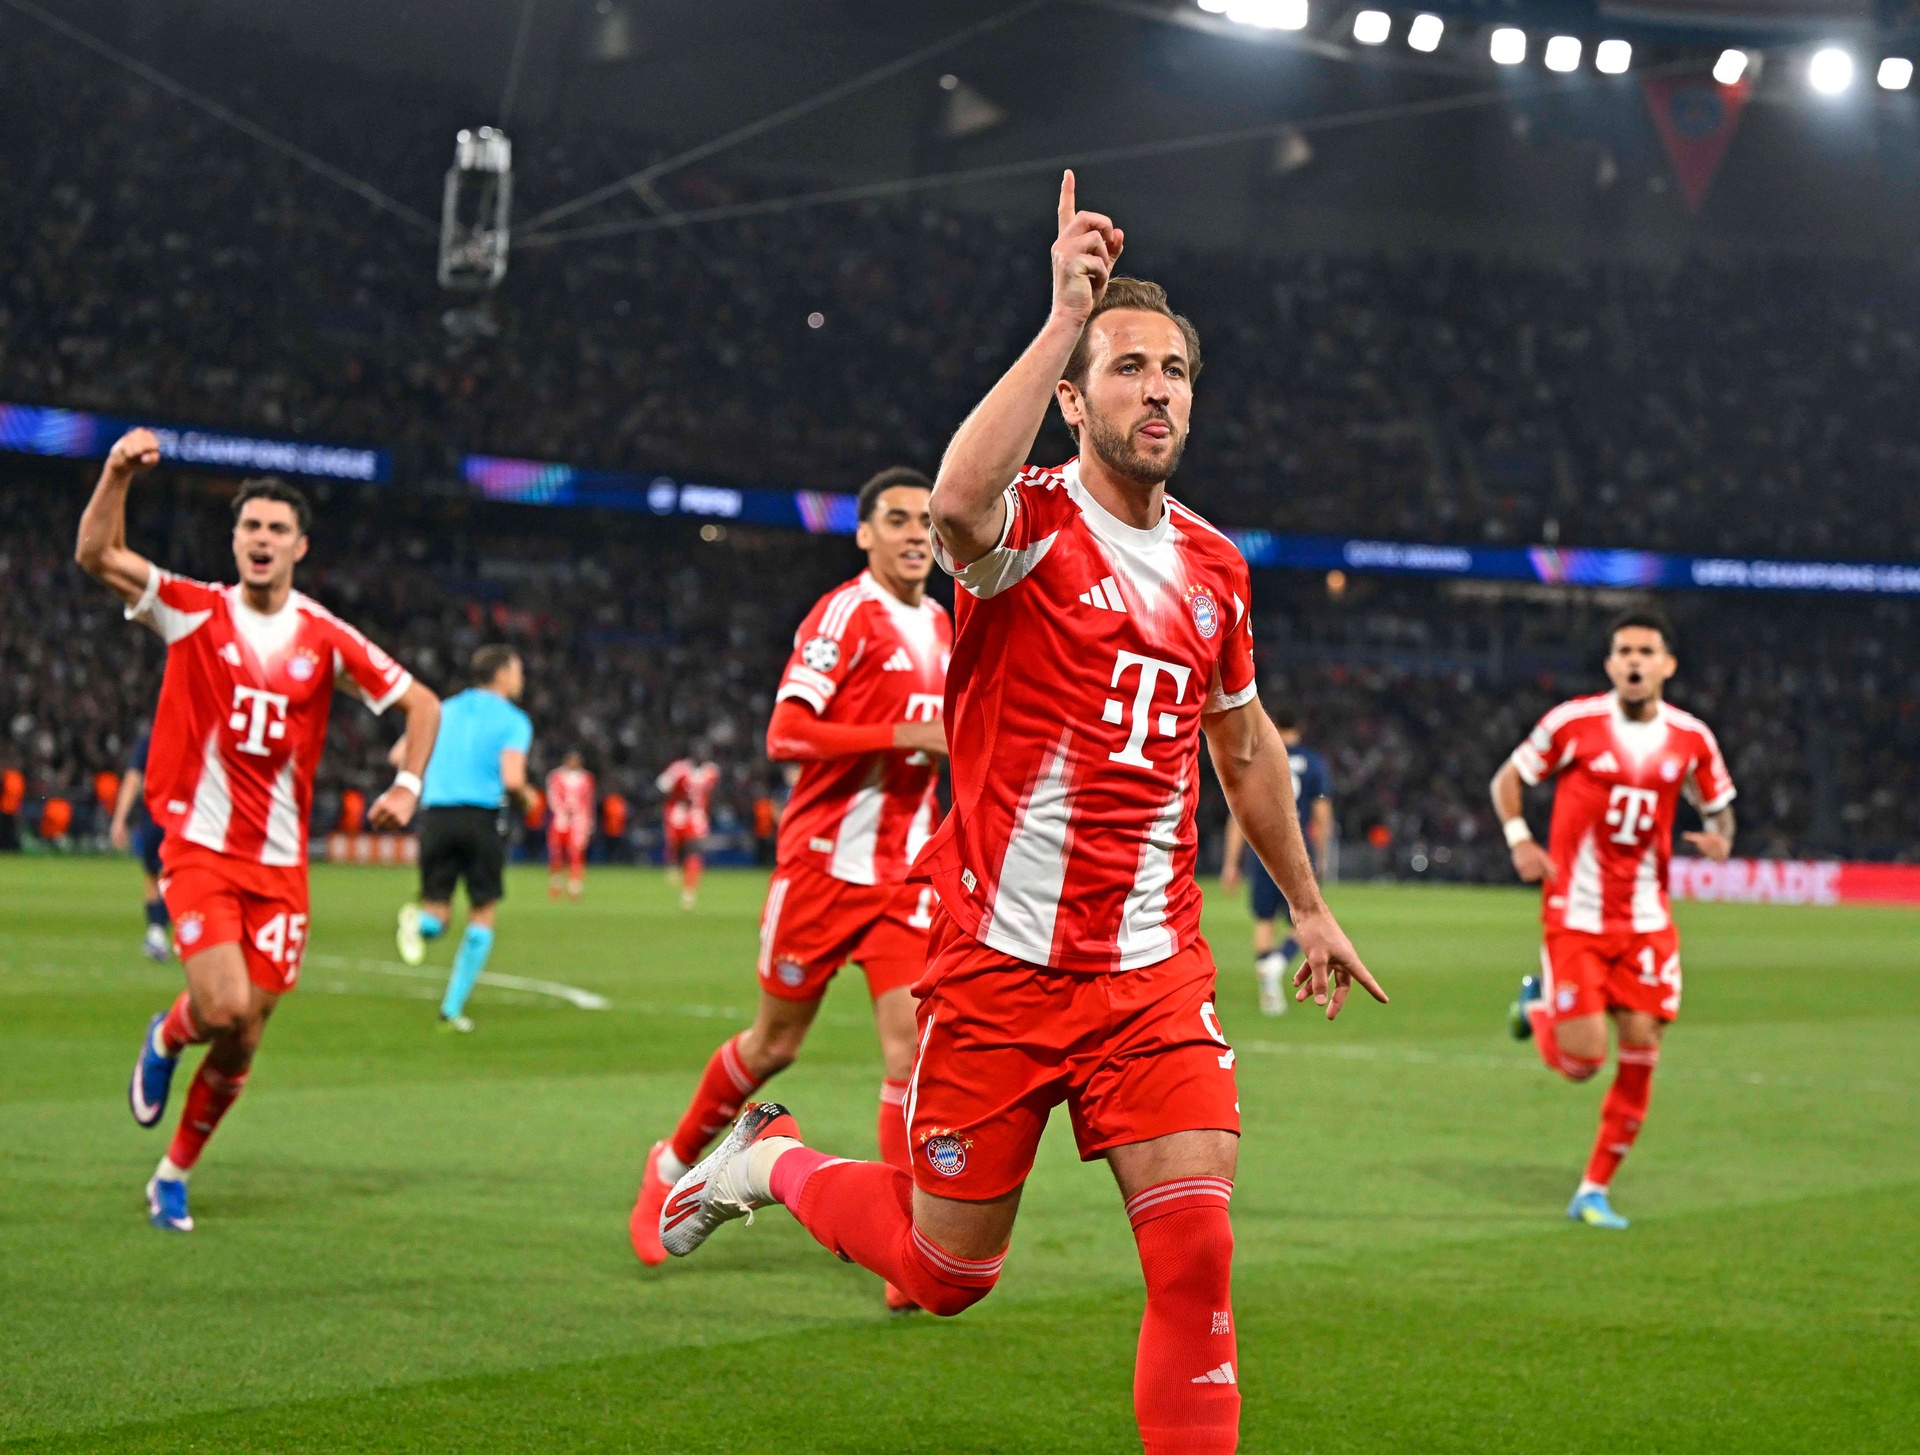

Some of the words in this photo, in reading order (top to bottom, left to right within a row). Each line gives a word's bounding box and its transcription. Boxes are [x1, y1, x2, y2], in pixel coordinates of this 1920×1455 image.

[228, 684, 289, 757] T
[1101, 649, 1192, 770] T
[1605, 784, 1659, 846] T
[256, 912, 307, 963] 45
[1636, 945, 1682, 1013] 14
[930, 1142, 937, 1151] FC
[936, 1139, 962, 1155] BAYERN
[1212, 1319, 1228, 1327] SAN
[1213, 1311, 1228, 1319] MIA
